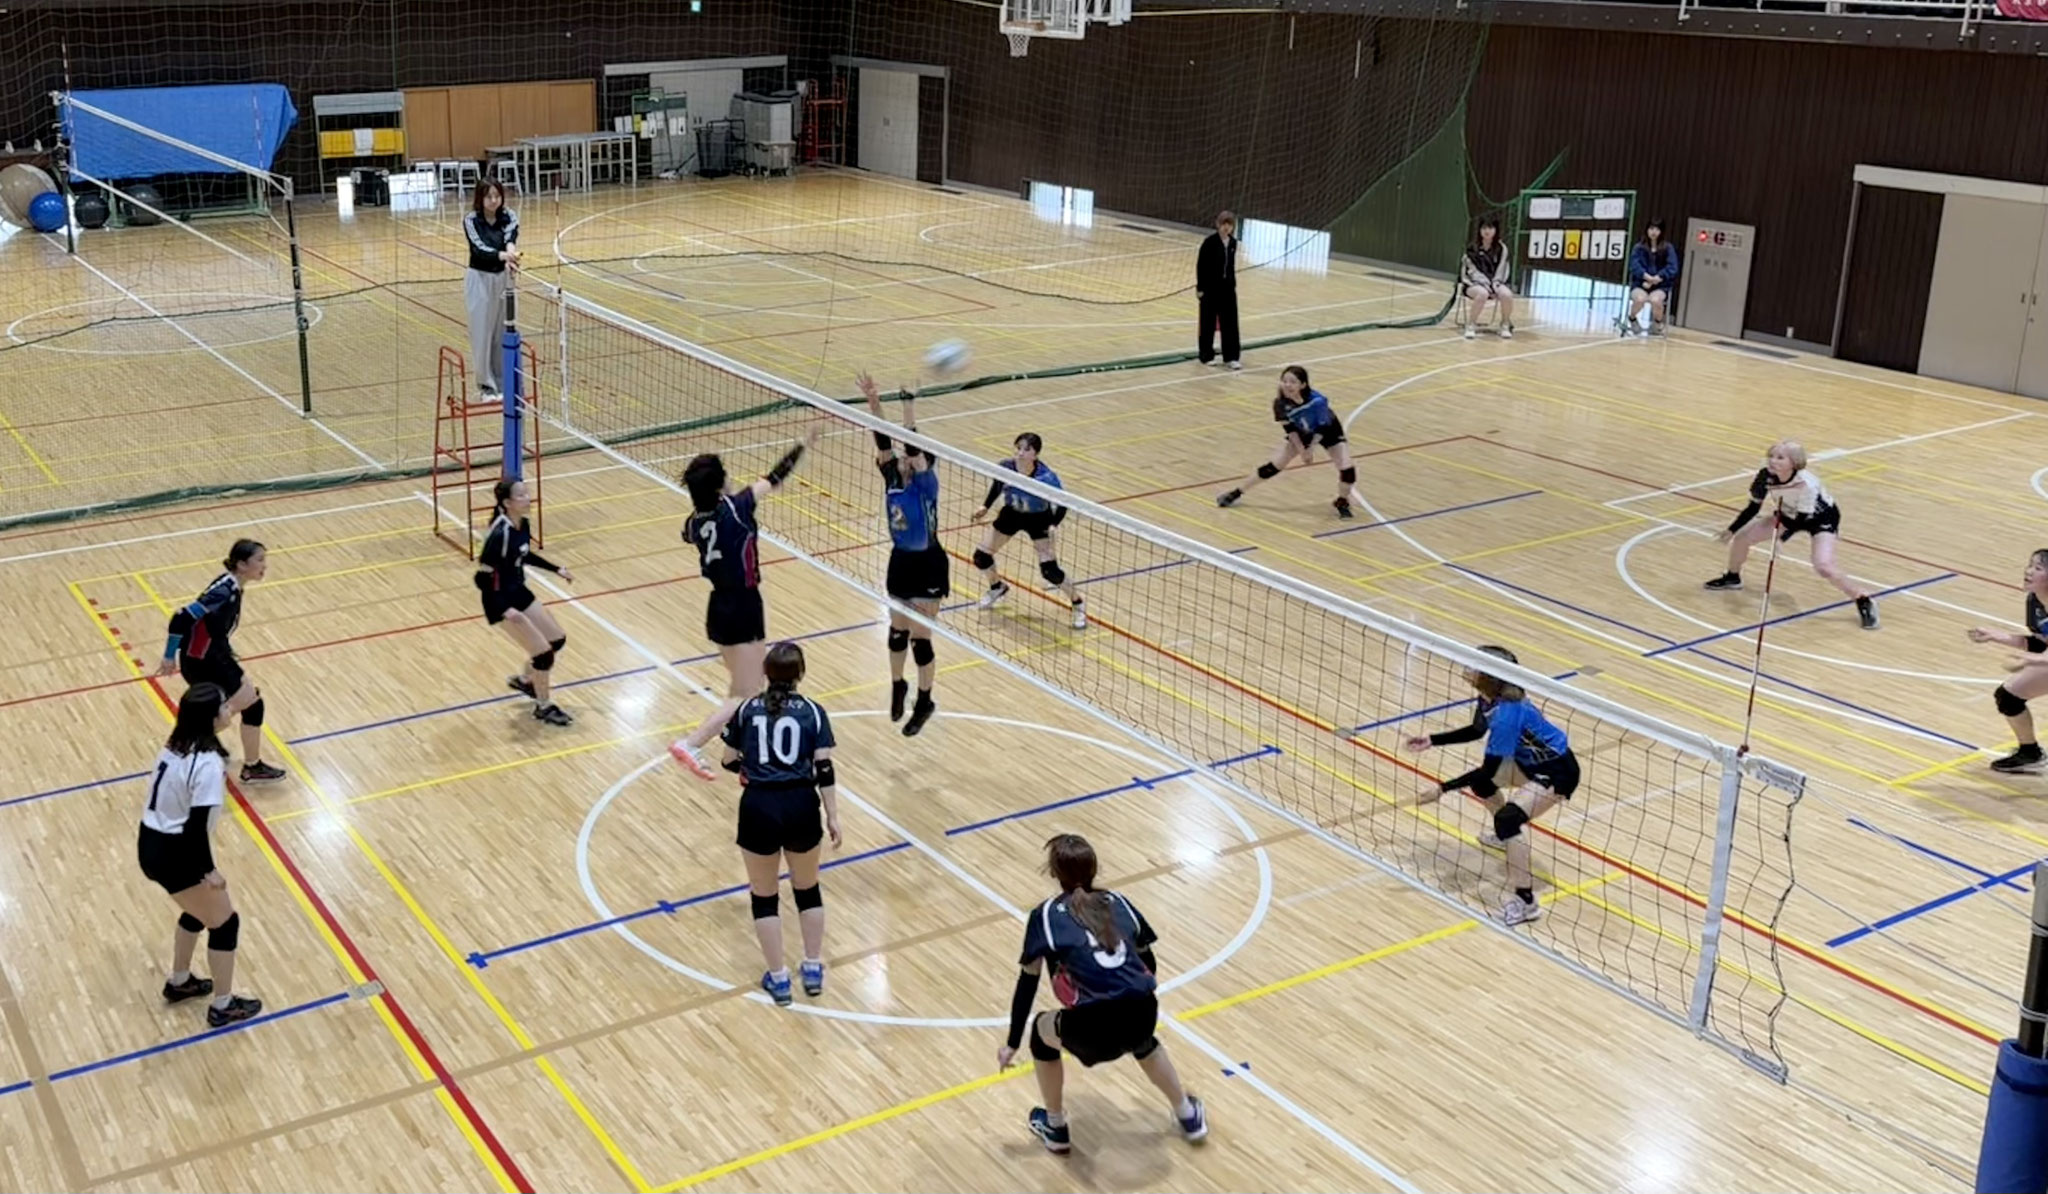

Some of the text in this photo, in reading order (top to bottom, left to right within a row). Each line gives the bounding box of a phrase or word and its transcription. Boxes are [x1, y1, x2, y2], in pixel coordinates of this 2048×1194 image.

[1533, 242, 1622, 257] 19 0 15
[700, 520, 722, 565] 2
[752, 715, 801, 765] 10
[148, 761, 168, 812] 1
